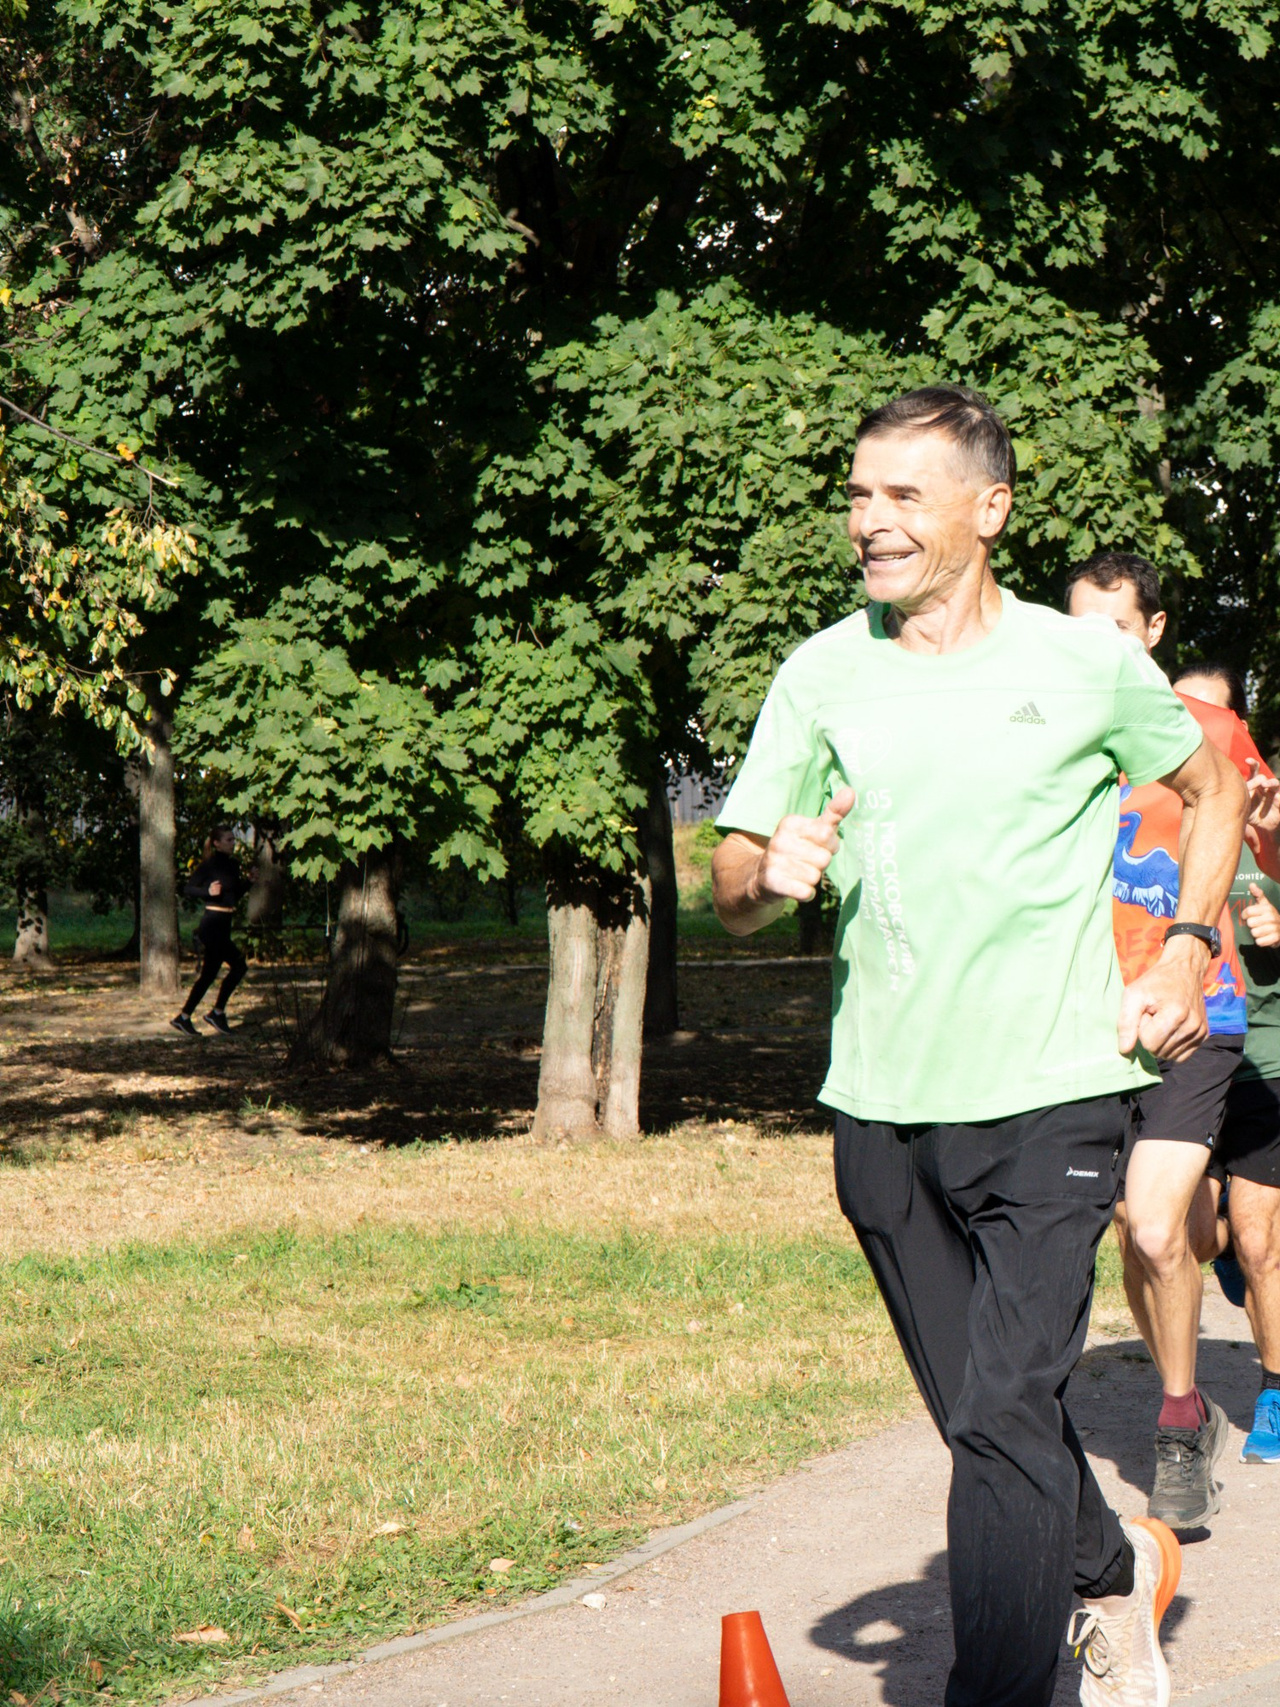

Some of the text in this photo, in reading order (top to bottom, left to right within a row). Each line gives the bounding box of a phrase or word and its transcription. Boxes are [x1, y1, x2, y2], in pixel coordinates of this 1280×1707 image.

[1009, 714, 1047, 726] adidas
[880, 821, 917, 976] МОСКОВСКИЙ
[1072, 1169, 1100, 1178] DEMIX
